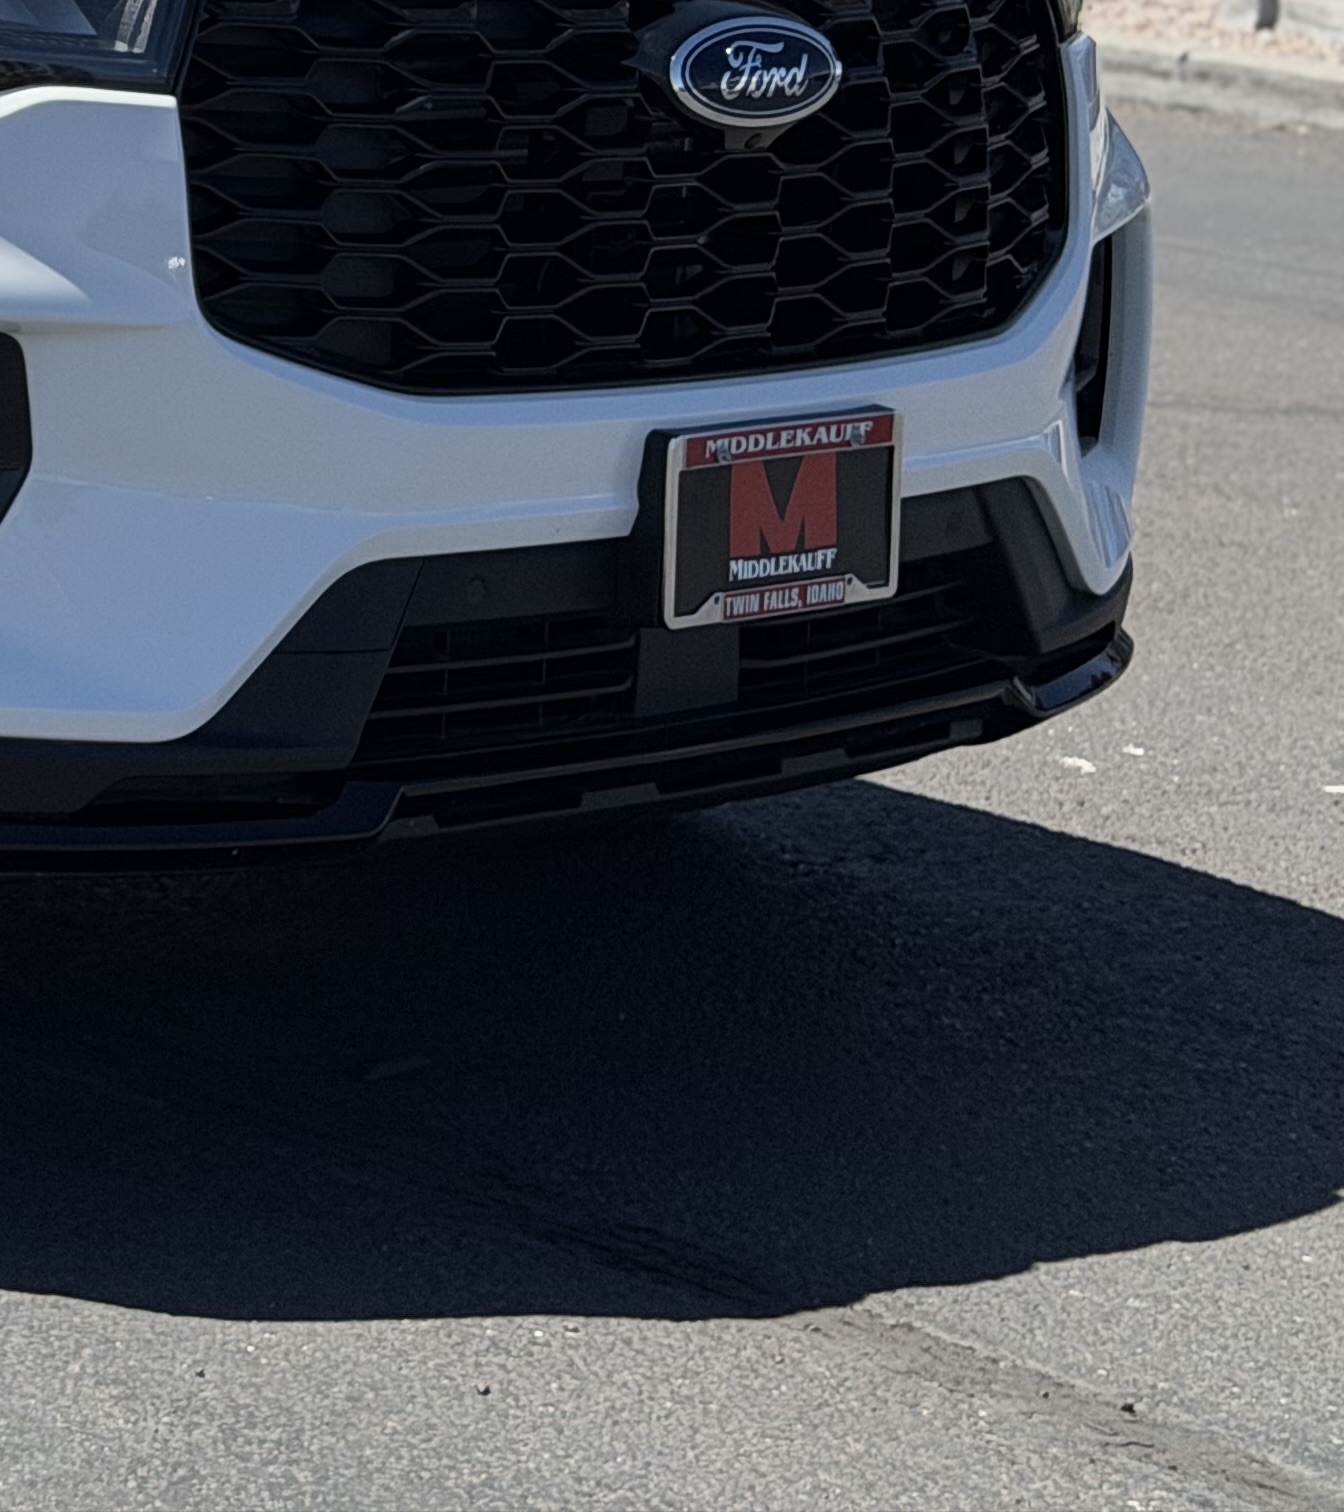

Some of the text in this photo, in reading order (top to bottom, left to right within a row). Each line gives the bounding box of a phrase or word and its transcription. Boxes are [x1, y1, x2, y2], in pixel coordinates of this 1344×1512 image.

[720, 40, 809, 101] Ford
[729, 451, 837, 558] M
[729, 548, 837, 582] MIDDLEKAUFF
[725, 581, 844, 617] TWIN FALLS, IDAHO
